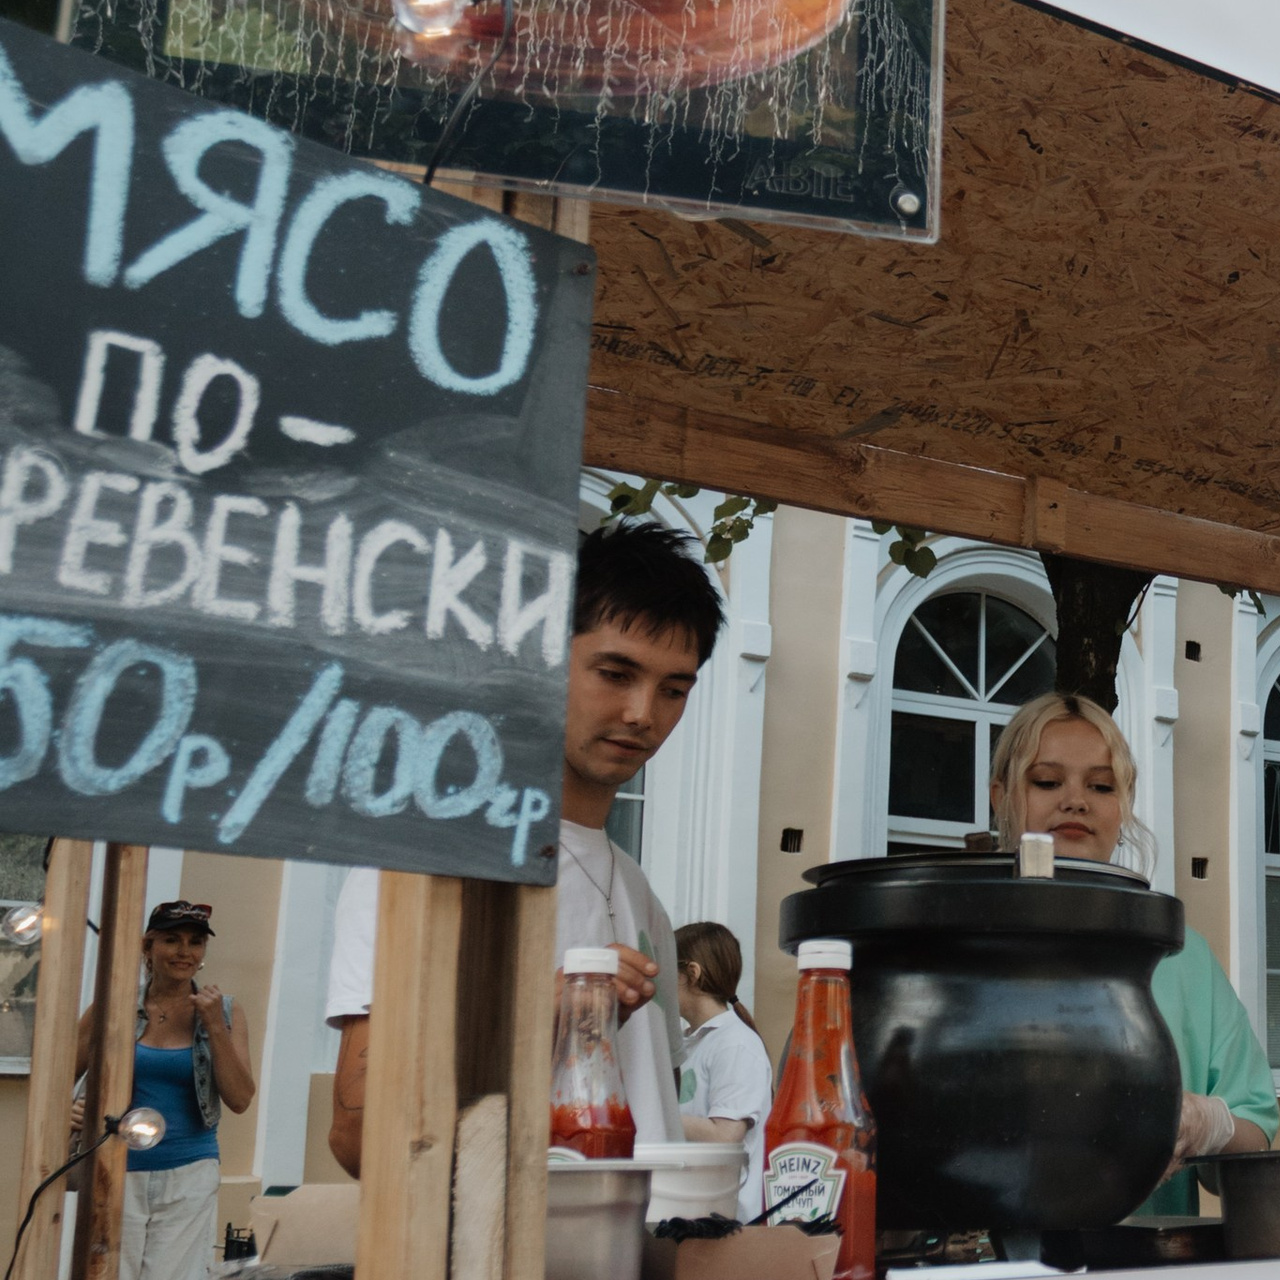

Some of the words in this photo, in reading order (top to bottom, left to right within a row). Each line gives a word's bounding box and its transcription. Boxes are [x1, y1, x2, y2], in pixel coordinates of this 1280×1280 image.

[0, 42, 537, 396] МЯСО
[0, 446, 578, 668] РЕВЕНСКИ
[779, 1157, 821, 1175] HEINZ
[783, 1197, 813, 1208] ЕТЧУП
